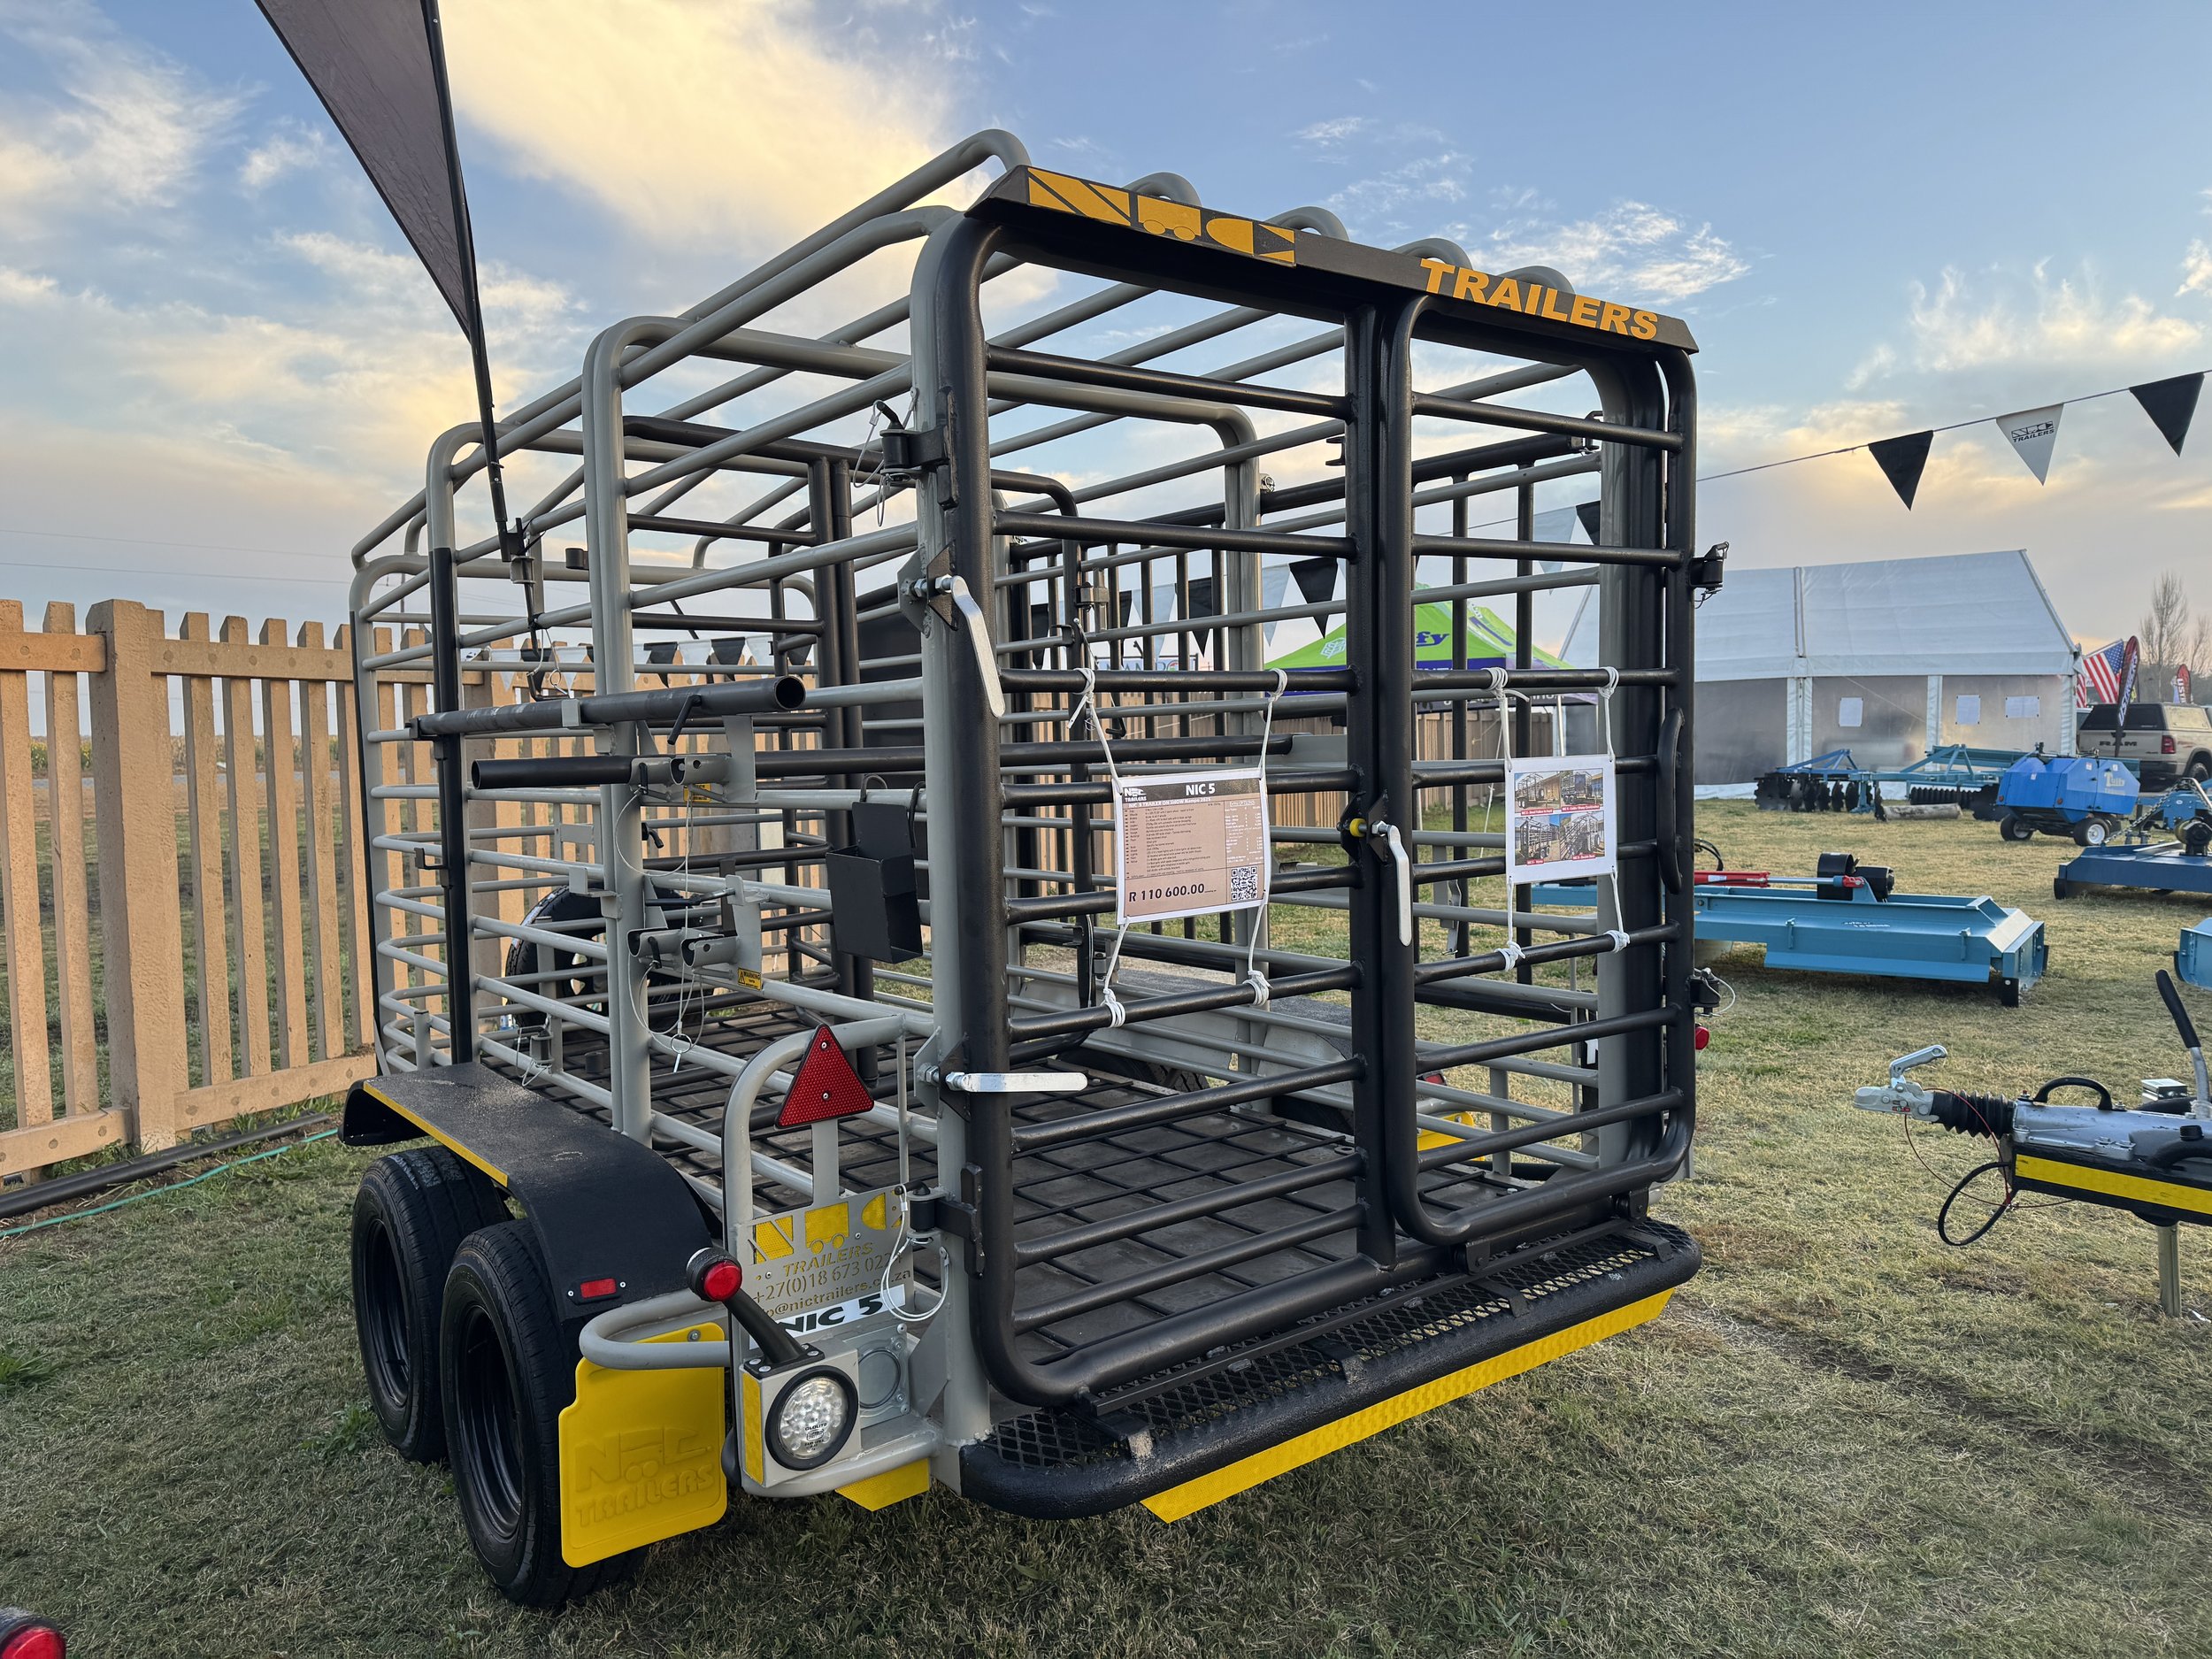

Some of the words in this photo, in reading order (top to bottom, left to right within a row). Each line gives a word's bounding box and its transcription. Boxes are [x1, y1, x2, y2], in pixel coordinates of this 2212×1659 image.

[1420, 258, 1659, 341] TRAILERS
[2012, 429, 2055, 443] TRAILERS
[1186, 783, 1206, 796] NIC
[1208, 783, 1216, 794] 5
[1128, 892, 1137, 902] R
[1141, 888, 1163, 901] 110
[1165, 883, 1205, 898] 600.00
[783, 1241, 874, 1278] TRAILERS
[753, 1270, 828, 1303] +27(0)18
[831, 1260, 860, 1282] 673
[779, 1306, 846, 1333] NIC
[858, 1293, 883, 1316] 5
[575, 1463, 716, 1528] TRAILERS
